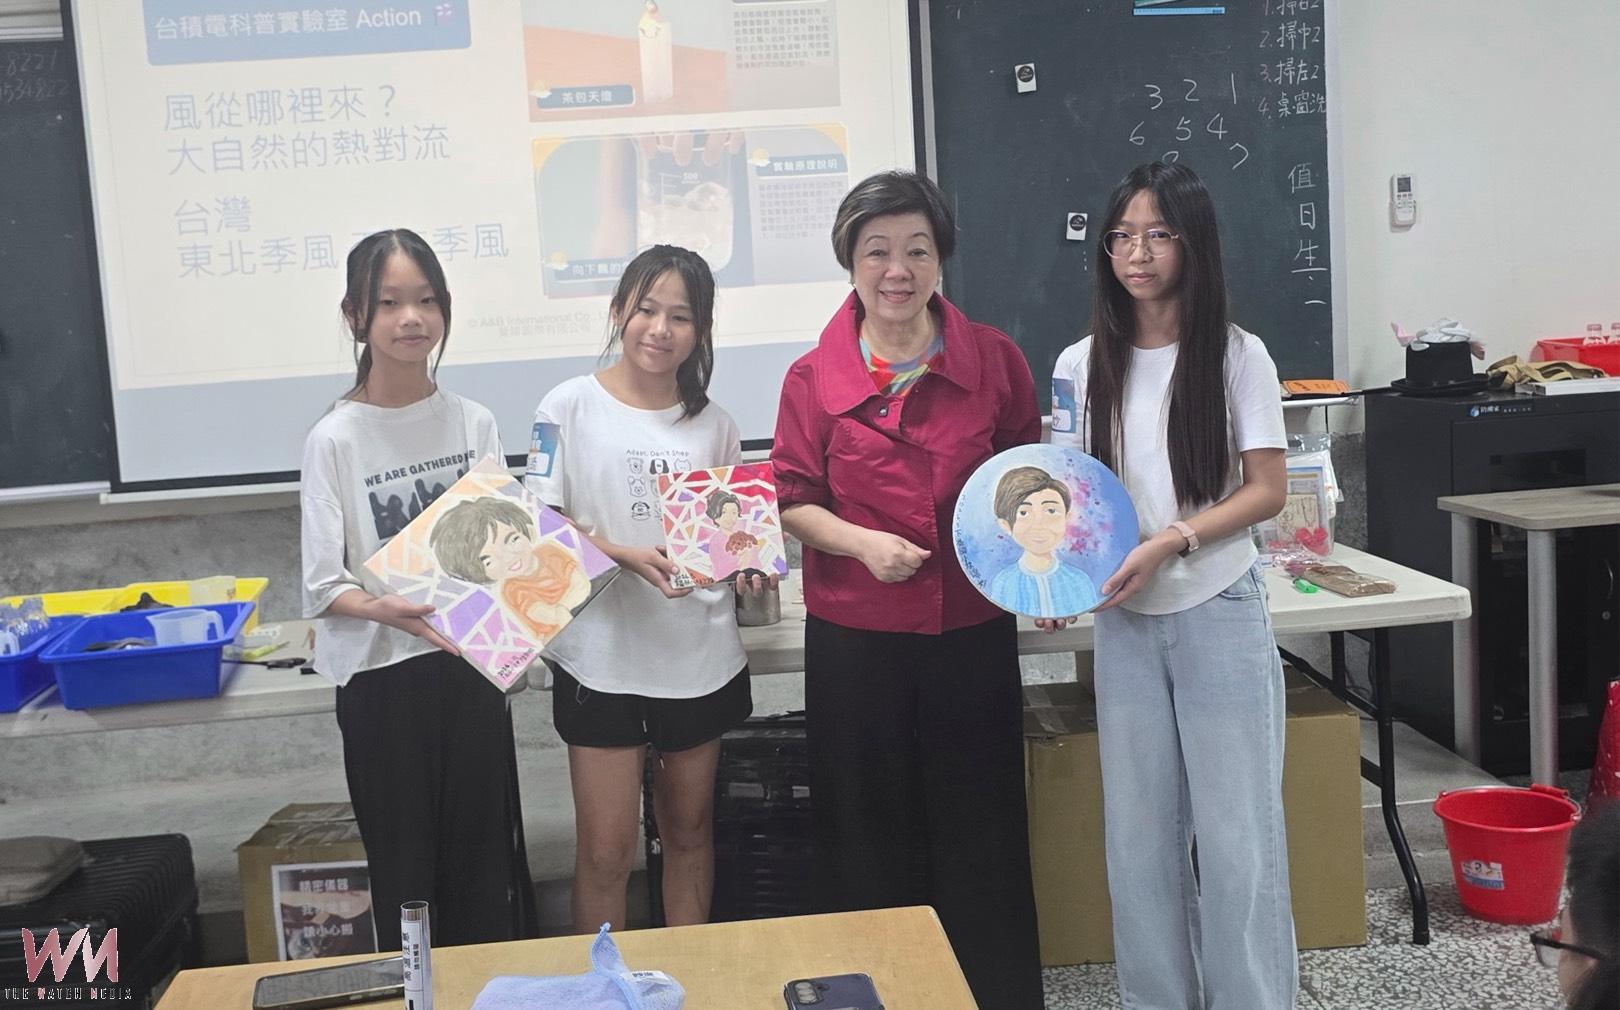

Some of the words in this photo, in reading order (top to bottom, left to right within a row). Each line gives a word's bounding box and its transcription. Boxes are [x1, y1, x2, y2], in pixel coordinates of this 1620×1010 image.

[155, 8, 349, 40] 台積電科普實驗室
[356, 8, 422, 29] Action
[164, 84, 396, 132] 風從哪裡來？
[1144, 83, 1163, 110] 3
[1183, 78, 1200, 102] 2
[1128, 121, 1145, 145] 6
[1175, 116, 1192, 141] 5
[1206, 113, 1228, 140] 4
[168, 123, 452, 176] 大自然的熱對流
[174, 195, 252, 237] 台灣
[177, 233, 339, 279] 東北季風
[364, 474, 382, 488] WE
[384, 467, 407, 482] ARE
[409, 453, 464, 475] GATHERED
